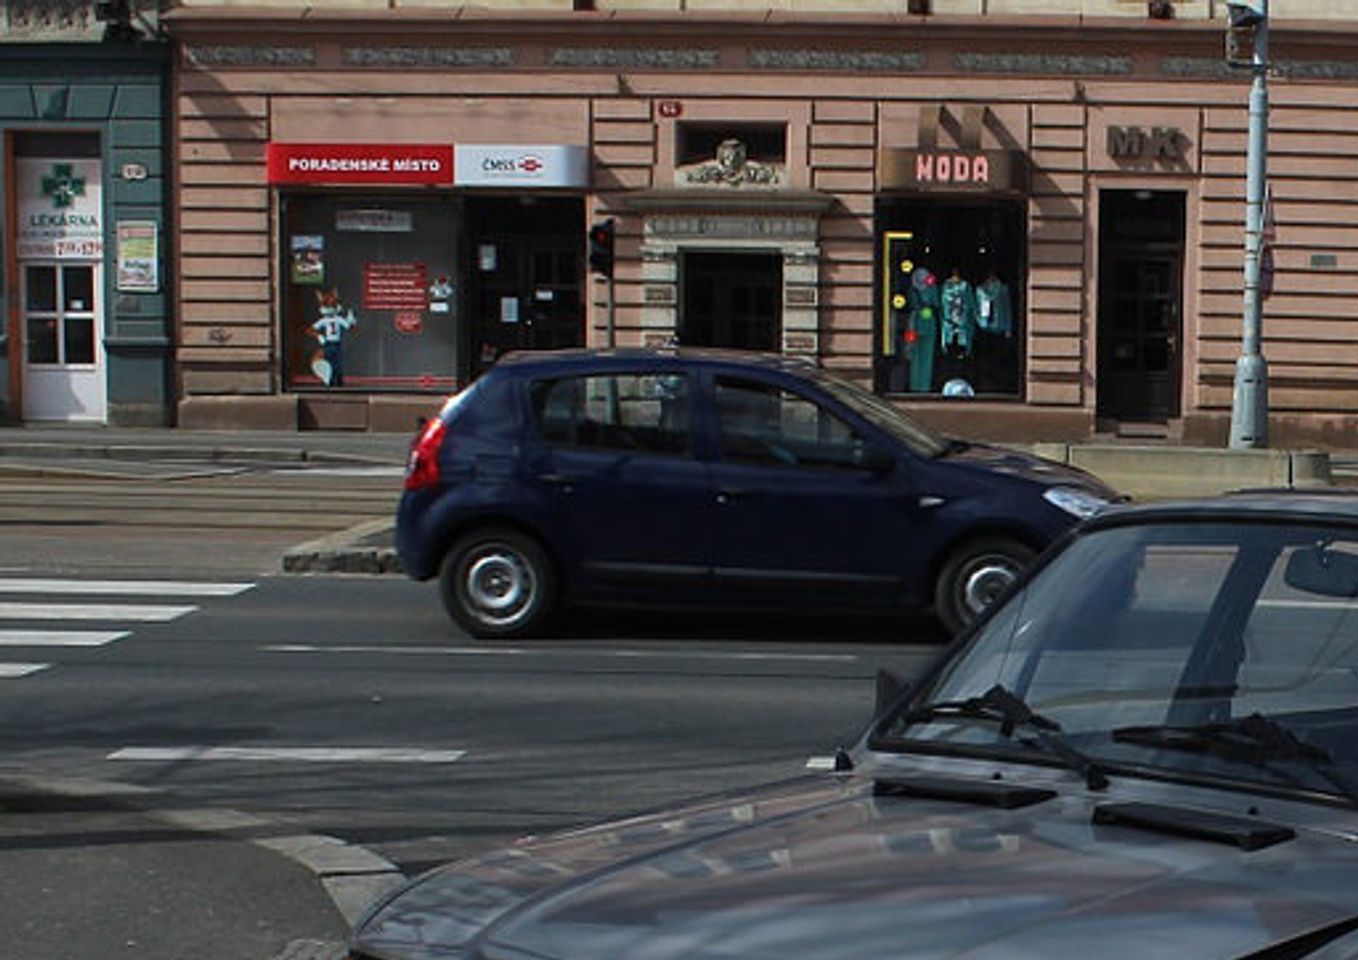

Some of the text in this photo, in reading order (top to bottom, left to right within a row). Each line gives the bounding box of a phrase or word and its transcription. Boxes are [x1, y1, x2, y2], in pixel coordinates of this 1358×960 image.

[289, 157, 440, 171] PORADENSKÉ MÍSTO
[916, 154, 988, 182] MODA
